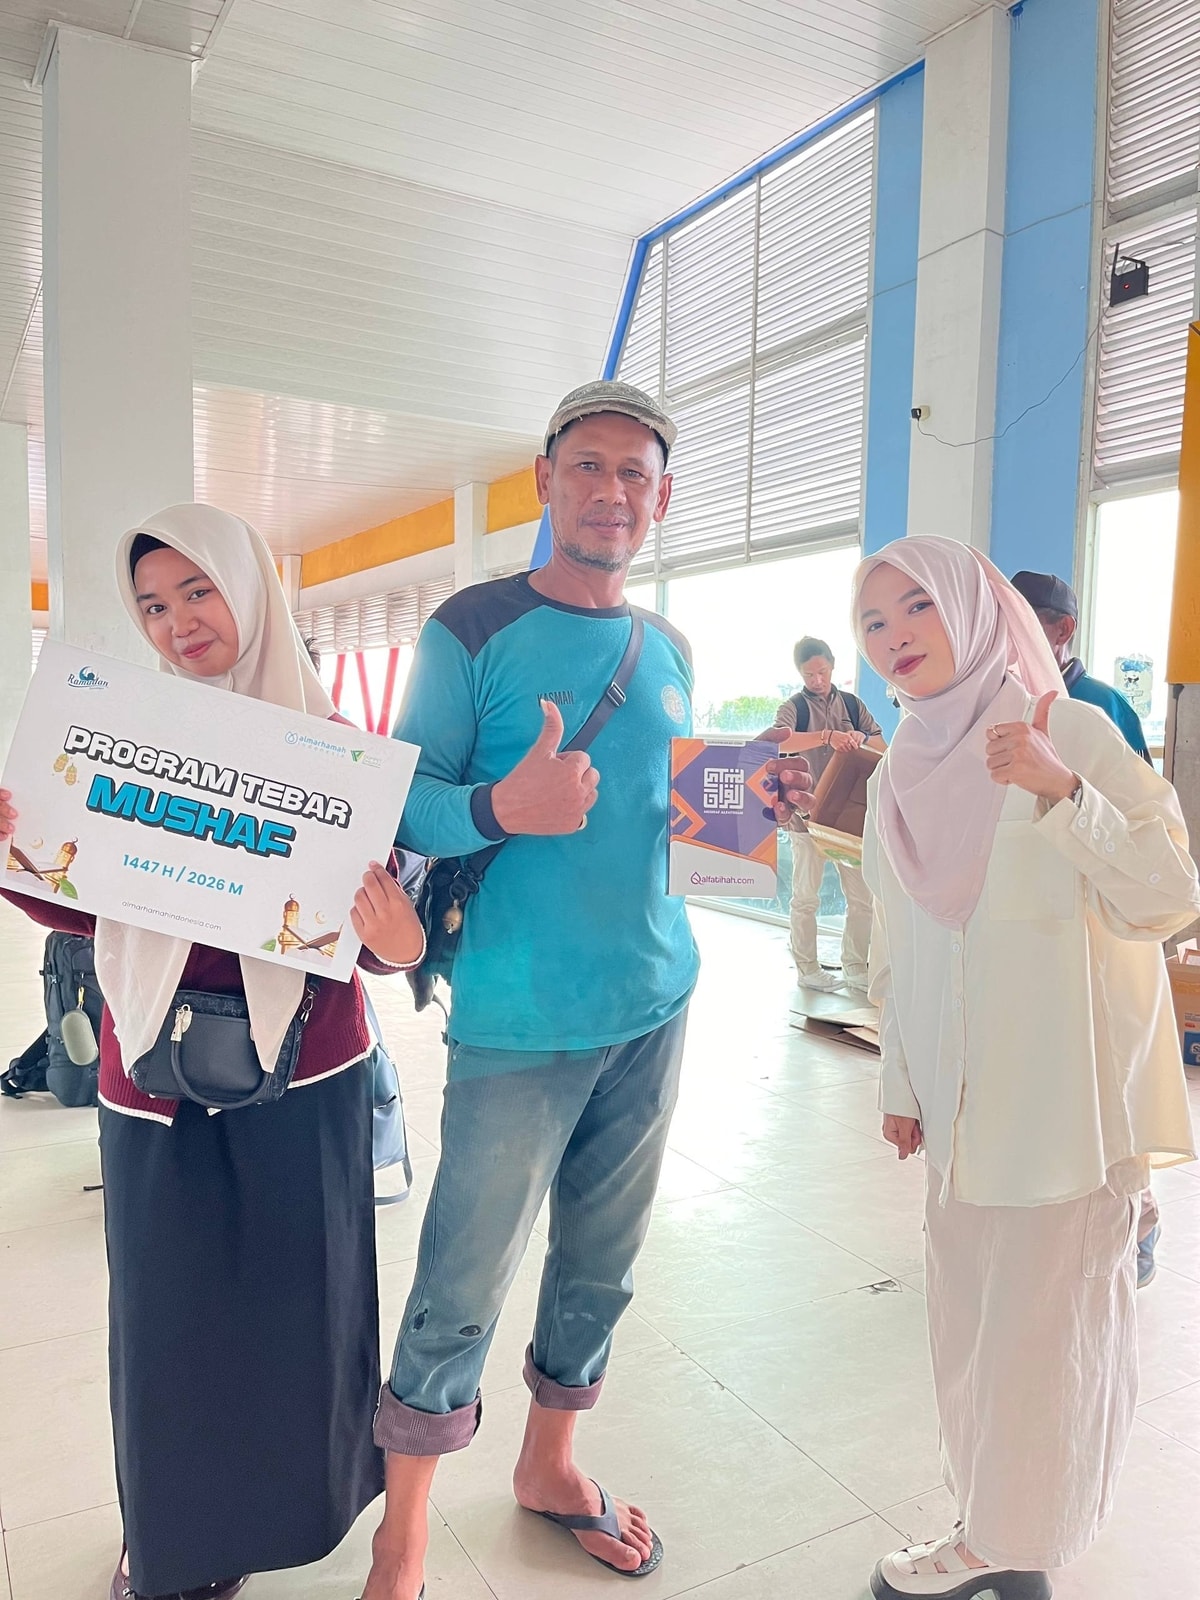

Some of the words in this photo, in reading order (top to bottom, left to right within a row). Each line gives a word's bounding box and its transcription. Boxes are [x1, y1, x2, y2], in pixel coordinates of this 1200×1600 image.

[298, 735, 347, 754] almarhamah
[64, 725, 238, 797] PROGRAM
[241, 773, 352, 829] TEBAR
[86, 774, 297, 858] MUSHAF
[122, 854, 160, 874] 1447
[161, 865, 174, 878] H
[175, 866, 187, 883] /
[187, 871, 225, 891] 2026
[228, 882, 244, 896] M
[121, 900, 222, 931] almarhamahindonesia.com
